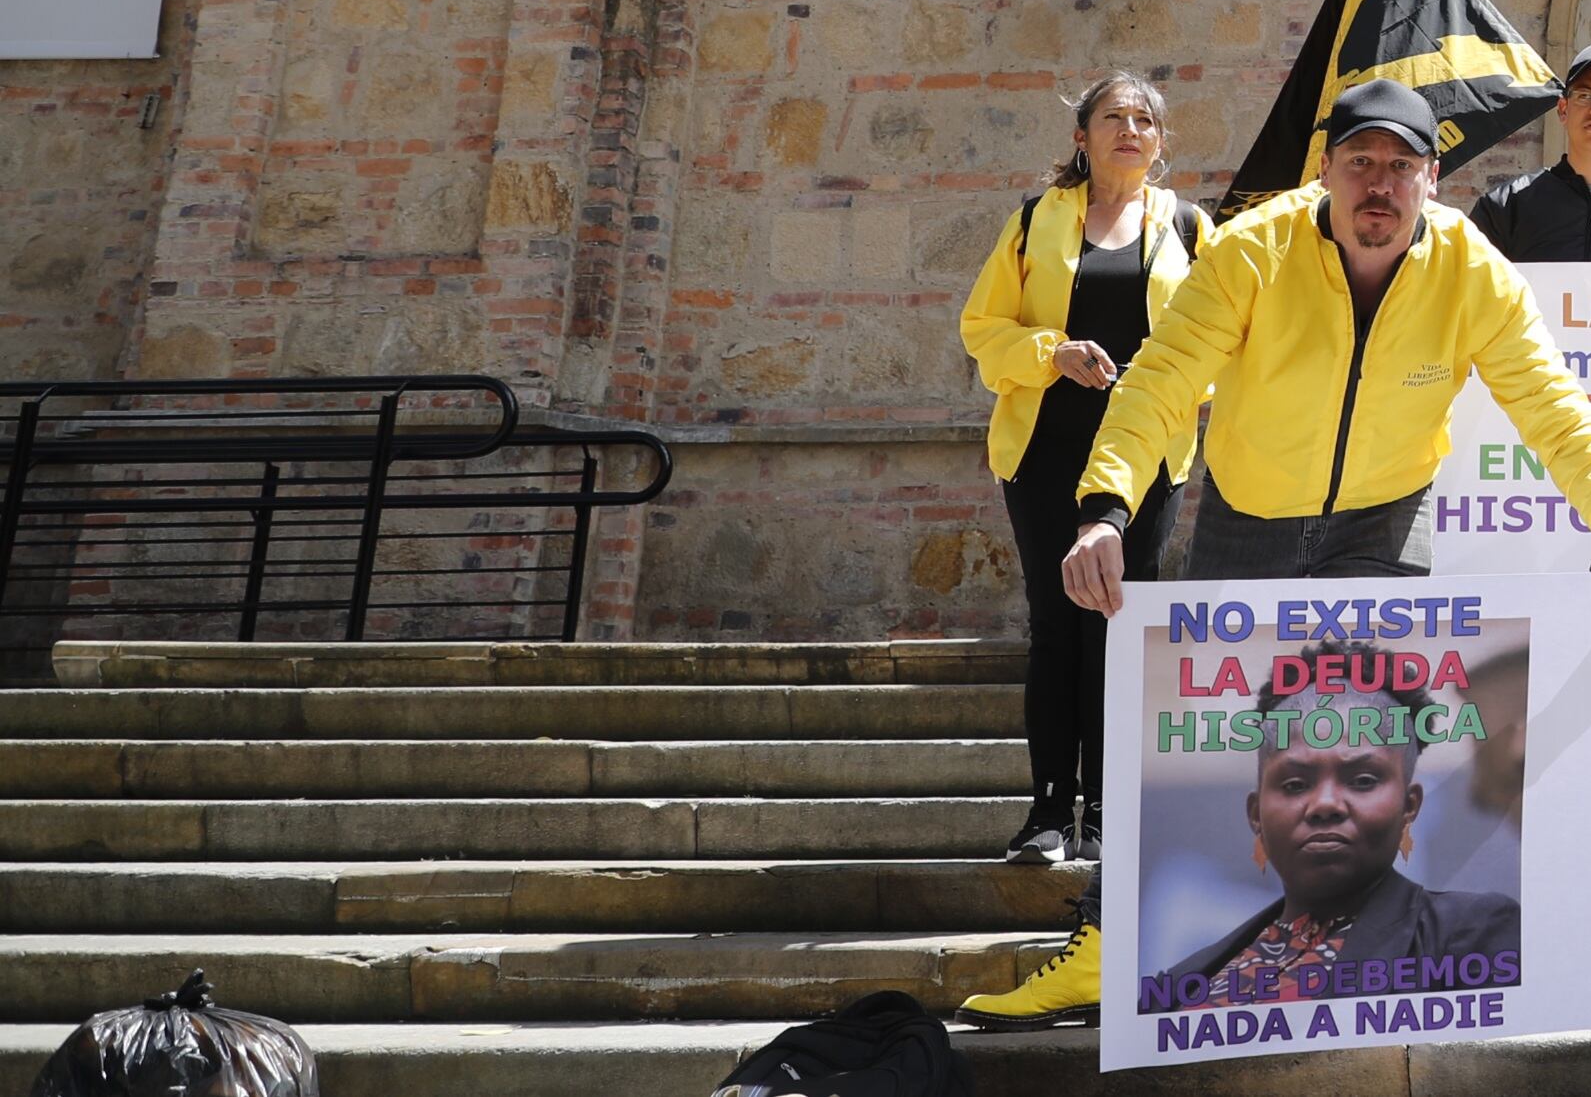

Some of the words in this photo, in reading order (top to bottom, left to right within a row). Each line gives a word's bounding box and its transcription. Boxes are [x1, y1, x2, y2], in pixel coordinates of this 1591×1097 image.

[1169, 601, 1254, 643] NO
[1277, 597, 1481, 641] EXISTE
[1179, 657, 1251, 697] LA
[1272, 650, 1470, 696] DEUDA
[1157, 694, 1488, 752] HISTÓRICA
[1140, 972, 1210, 1011] NO
[1228, 965, 1281, 1002] LE
[1298, 950, 1520, 995] DEBEMOS
[1157, 1007, 1293, 1052] NADA
[1306, 1004, 1340, 1039] A
[1355, 992, 1505, 1034] NADIE
